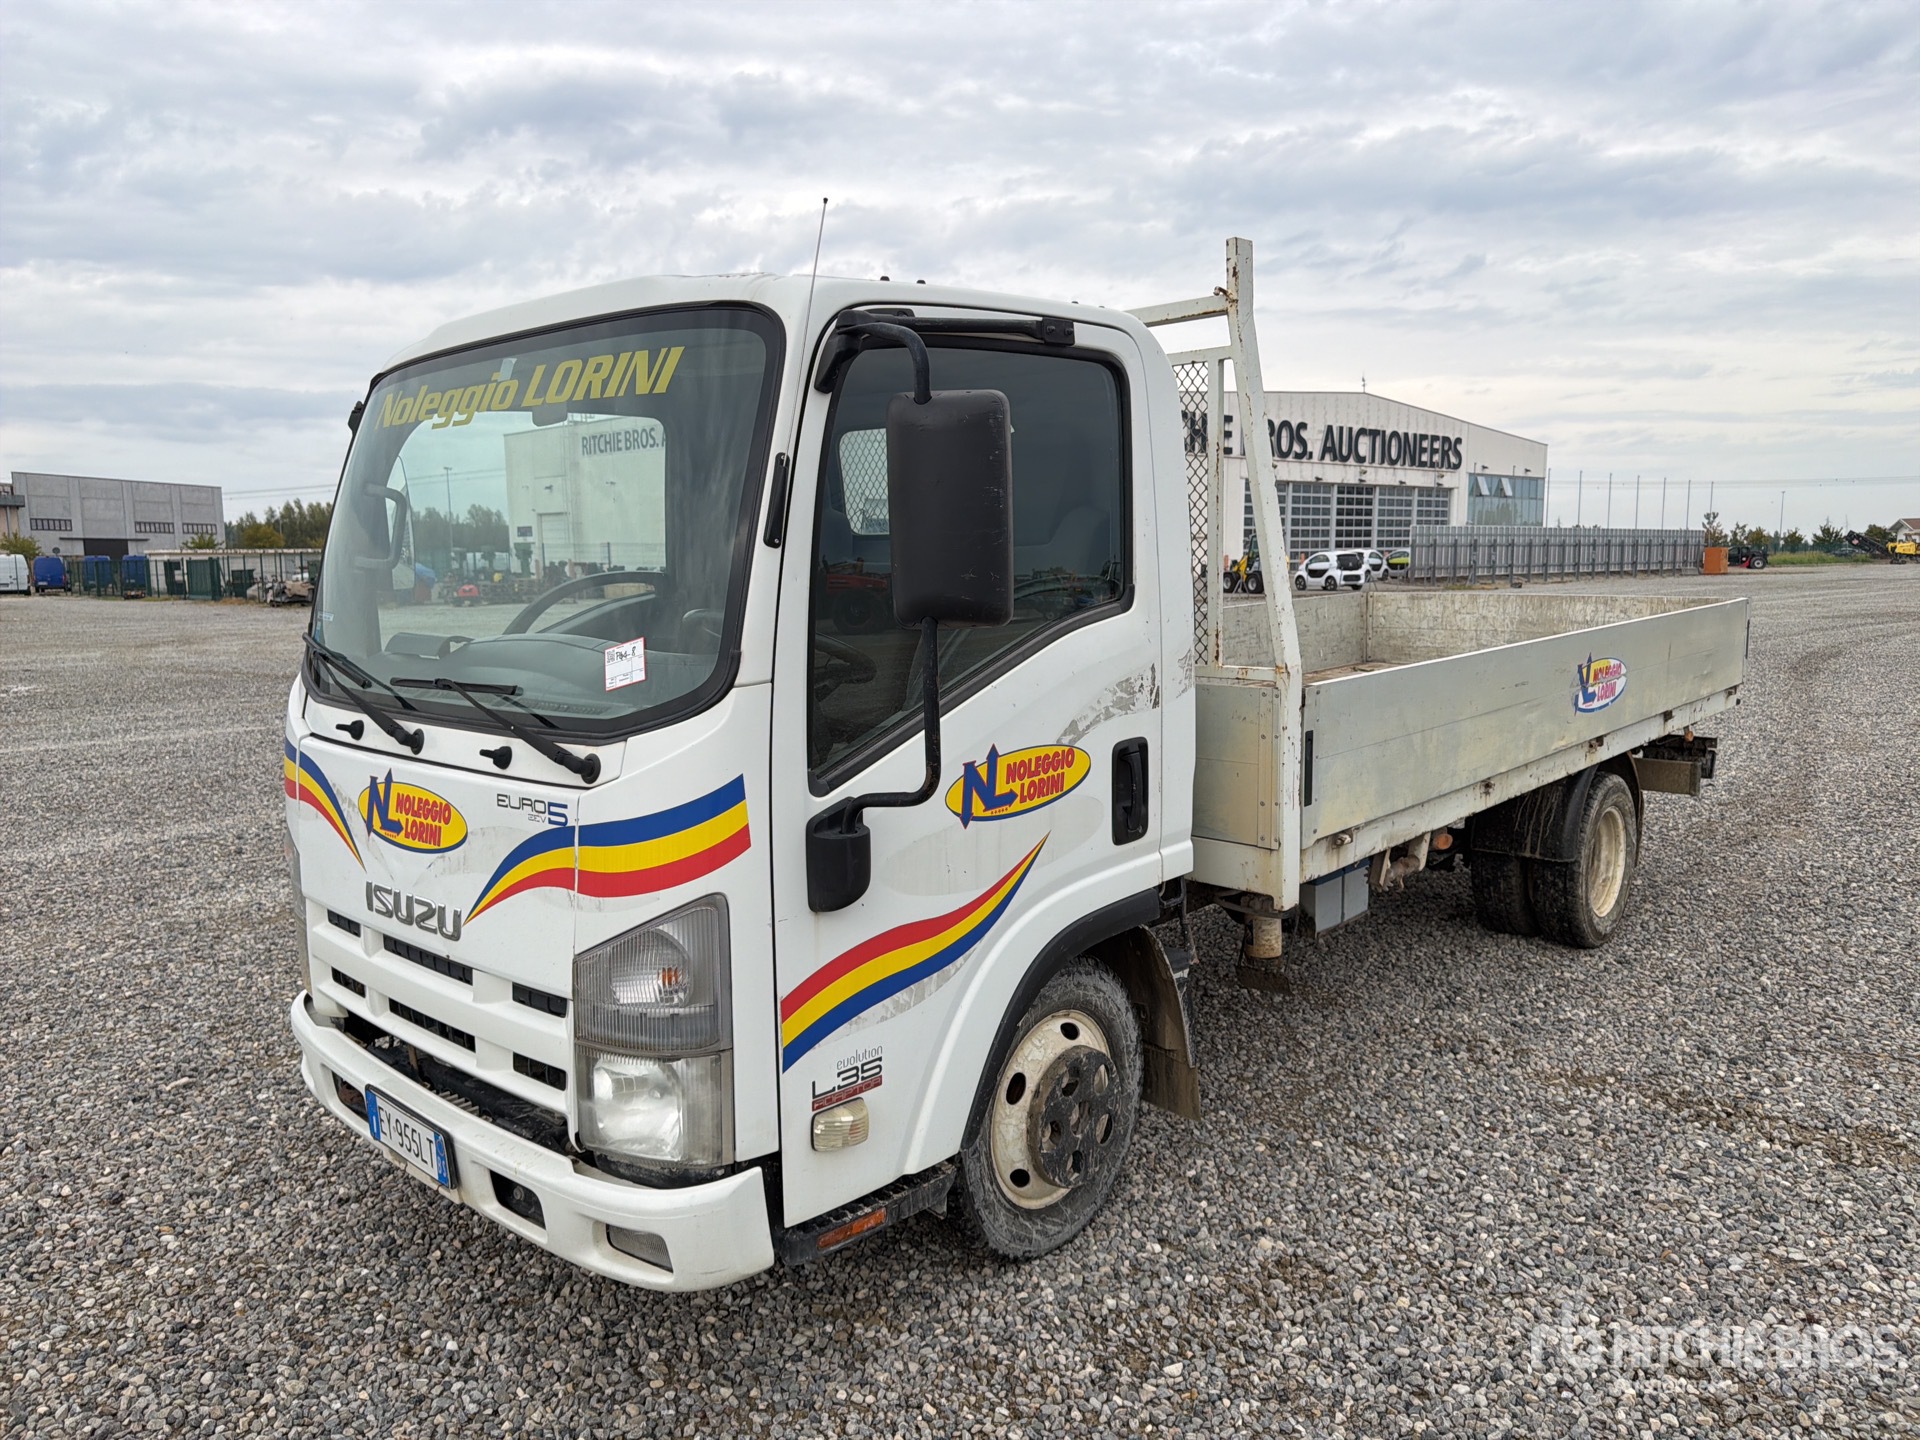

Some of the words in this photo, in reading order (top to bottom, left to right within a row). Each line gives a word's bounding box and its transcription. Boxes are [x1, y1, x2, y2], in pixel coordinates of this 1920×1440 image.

[375, 372, 519, 430] Noleggio
[521, 346, 686, 406] LORINI
[581, 431, 623, 456] RITCHIE
[624, 427, 660, 452] BROS.
[1318, 424, 1463, 470] AUCTIONEERS
[1006, 747, 1075, 784] NOLEGGIO
[1019, 771, 1065, 803] LORINI
[396, 792, 452, 825] NOLEGGIO
[404, 818, 442, 847] LORINI
[366, 880, 462, 942] ISUZU
[836, 1045, 883, 1070] evolution
